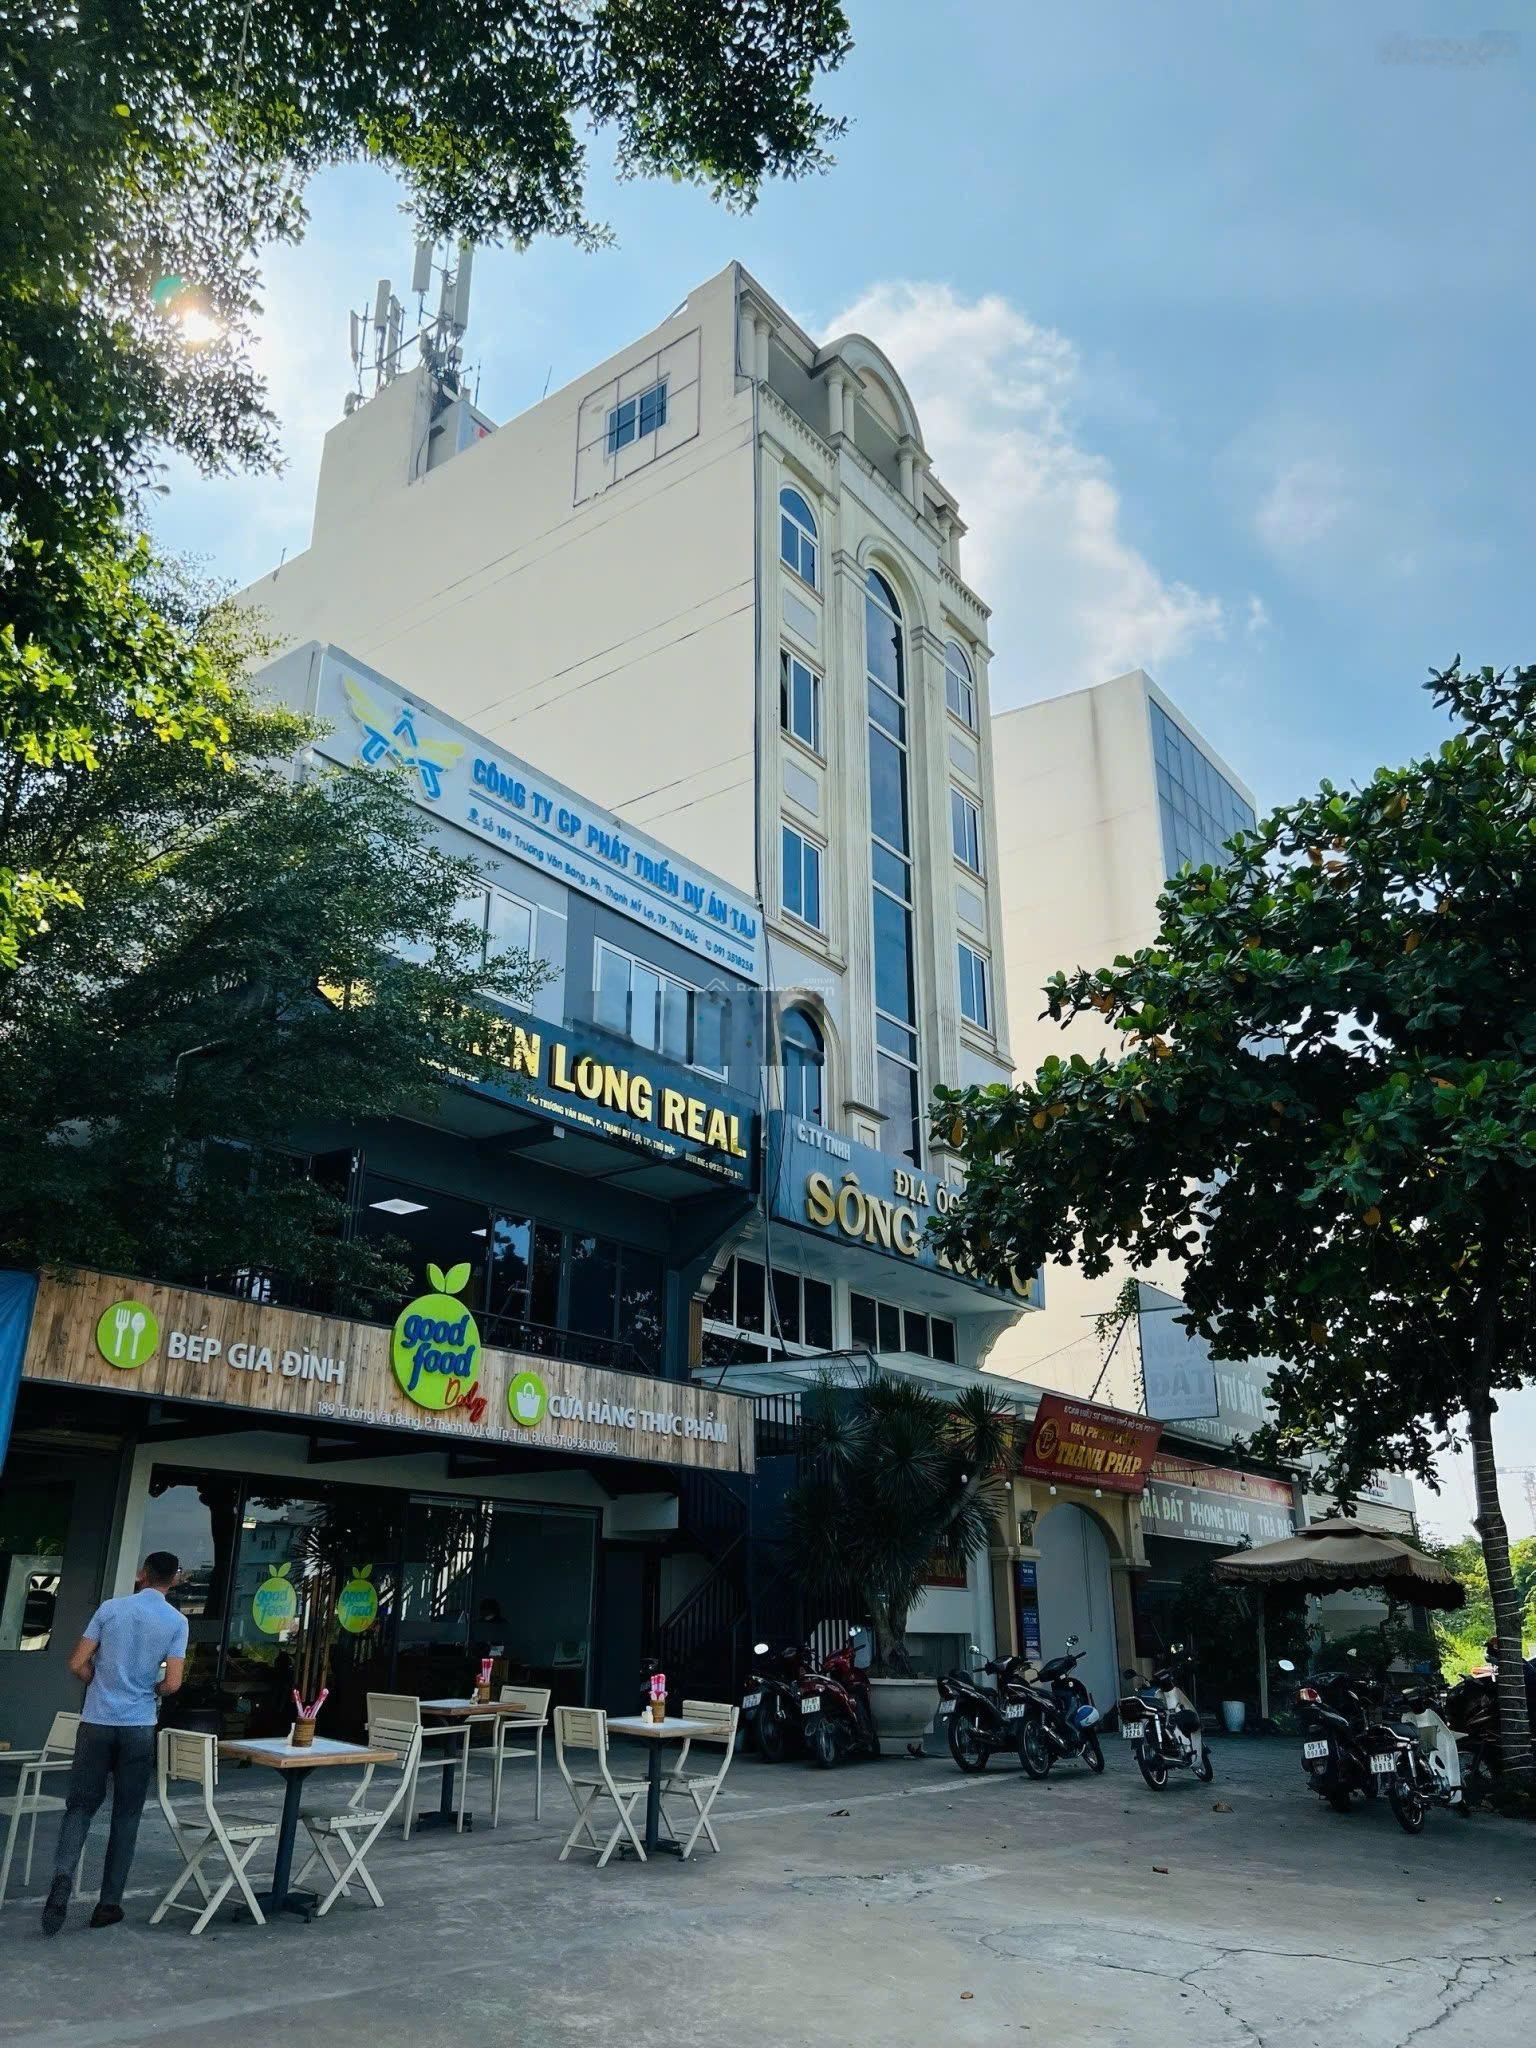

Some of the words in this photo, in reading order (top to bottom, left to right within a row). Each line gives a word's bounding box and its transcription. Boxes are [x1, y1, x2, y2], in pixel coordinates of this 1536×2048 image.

[472, 758, 526, 809] CÔNG
[530, 791, 553, 824] TY
[557, 808, 581, 838] CP
[585, 824, 630, 868] PHÁT
[682, 880, 705, 914] DỰ
[706, 891, 728, 925] ÁN
[730, 907, 756, 939] TAJ
[553, 1042, 653, 1122] LONG
[662, 1087, 747, 1159] REAL
[824, 1133, 851, 1161] TNHH
[894, 1168, 931, 1208] ĐỊA
[806, 1171, 921, 1259] SÔNG
[401, 1314, 471, 1349] good
[228, 1342, 273, 1374] GIA
[281, 1346, 346, 1385] ĐÌNH
[407, 1342, 476, 1392] food
[317, 1401, 335, 1416] 189
[549, 1389, 585, 1422] CỬA
[587, 1398, 636, 1429] HÀNG
[638, 1408, 683, 1441] THỰC
[1056, 1440, 1106, 1471] THÀNH
[1105, 1450, 1143, 1474] PHÁP
[1163, 1489, 1184, 1523] ĐẤT
[1190, 1501, 1224, 1529] PHONG
